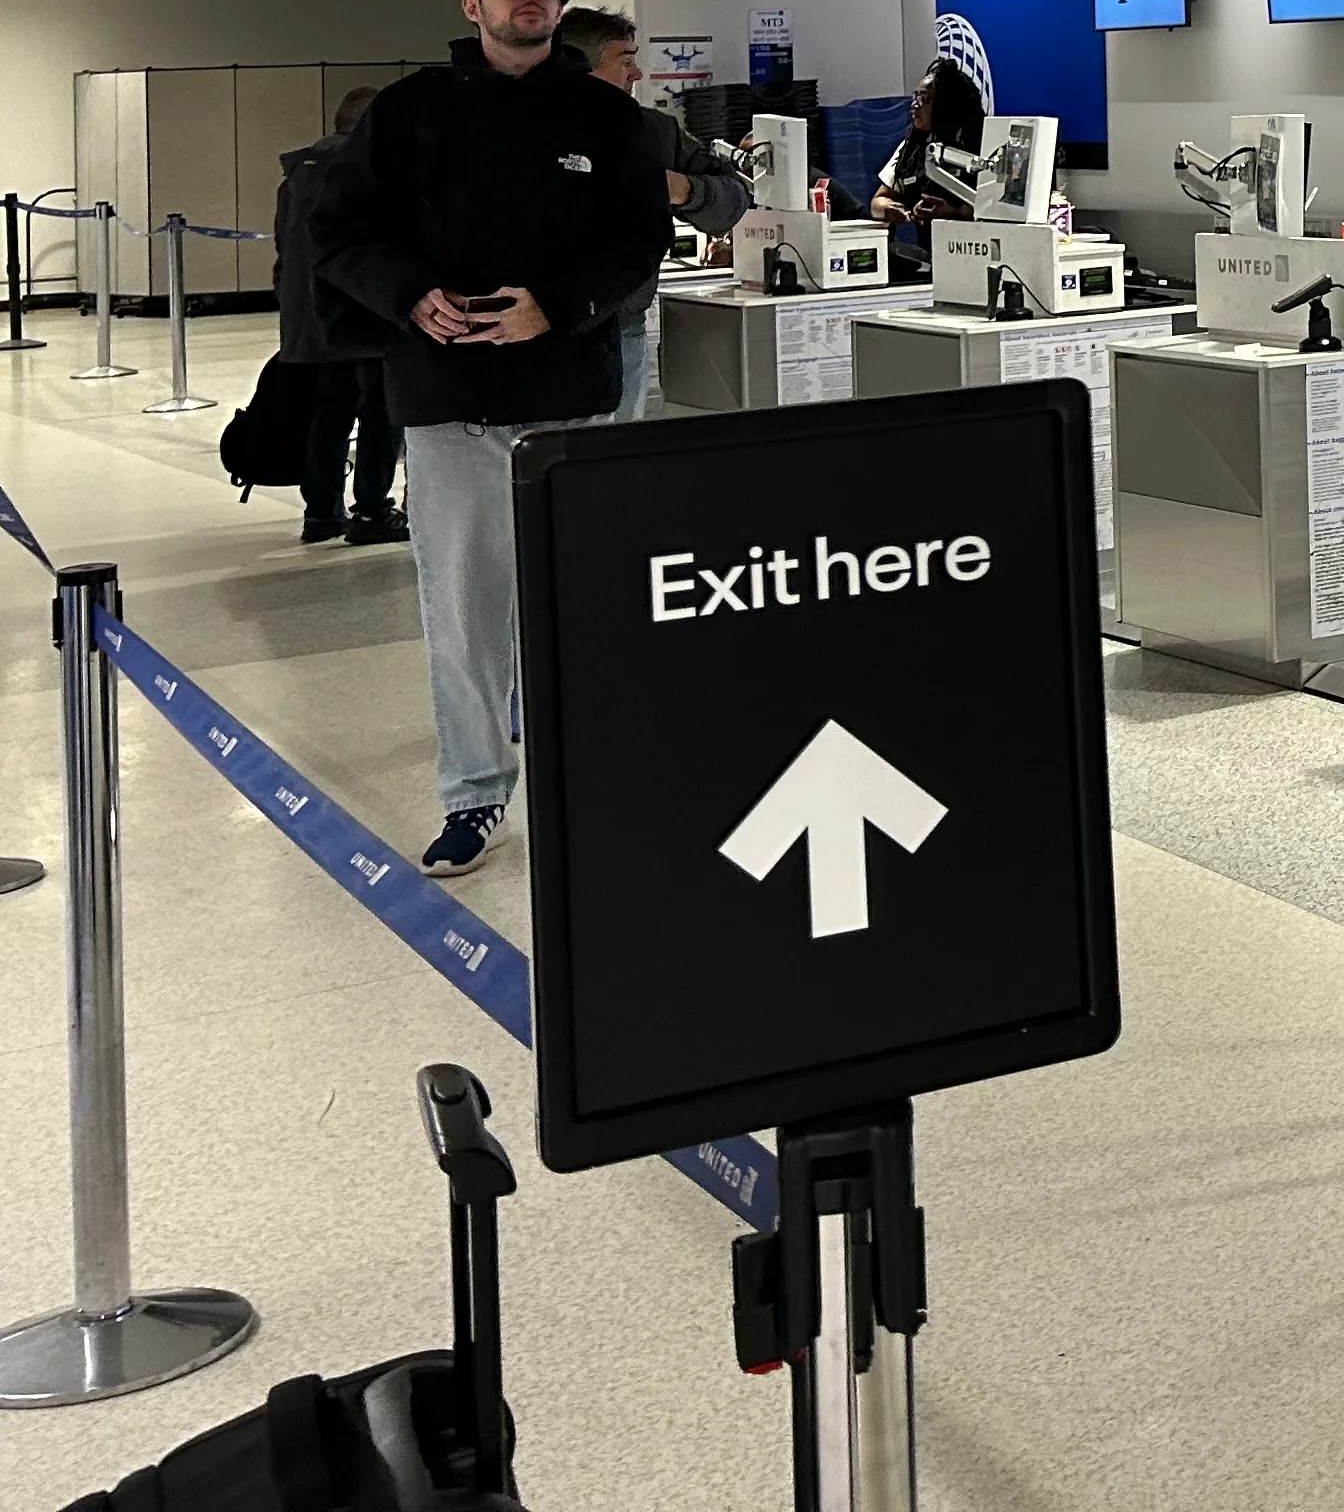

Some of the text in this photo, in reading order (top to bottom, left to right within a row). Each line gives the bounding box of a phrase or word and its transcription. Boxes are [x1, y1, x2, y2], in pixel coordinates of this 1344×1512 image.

[760, 17, 784, 28] MT3
[744, 226, 776, 240] UNITED
[948, 241, 990, 257] UNITED
[1217, 257, 1273, 277] UNITED
[649, 535, 992, 623] Exit here
[443, 928, 475, 960] UNITED
[697, 1141, 741, 1188] UNITED
